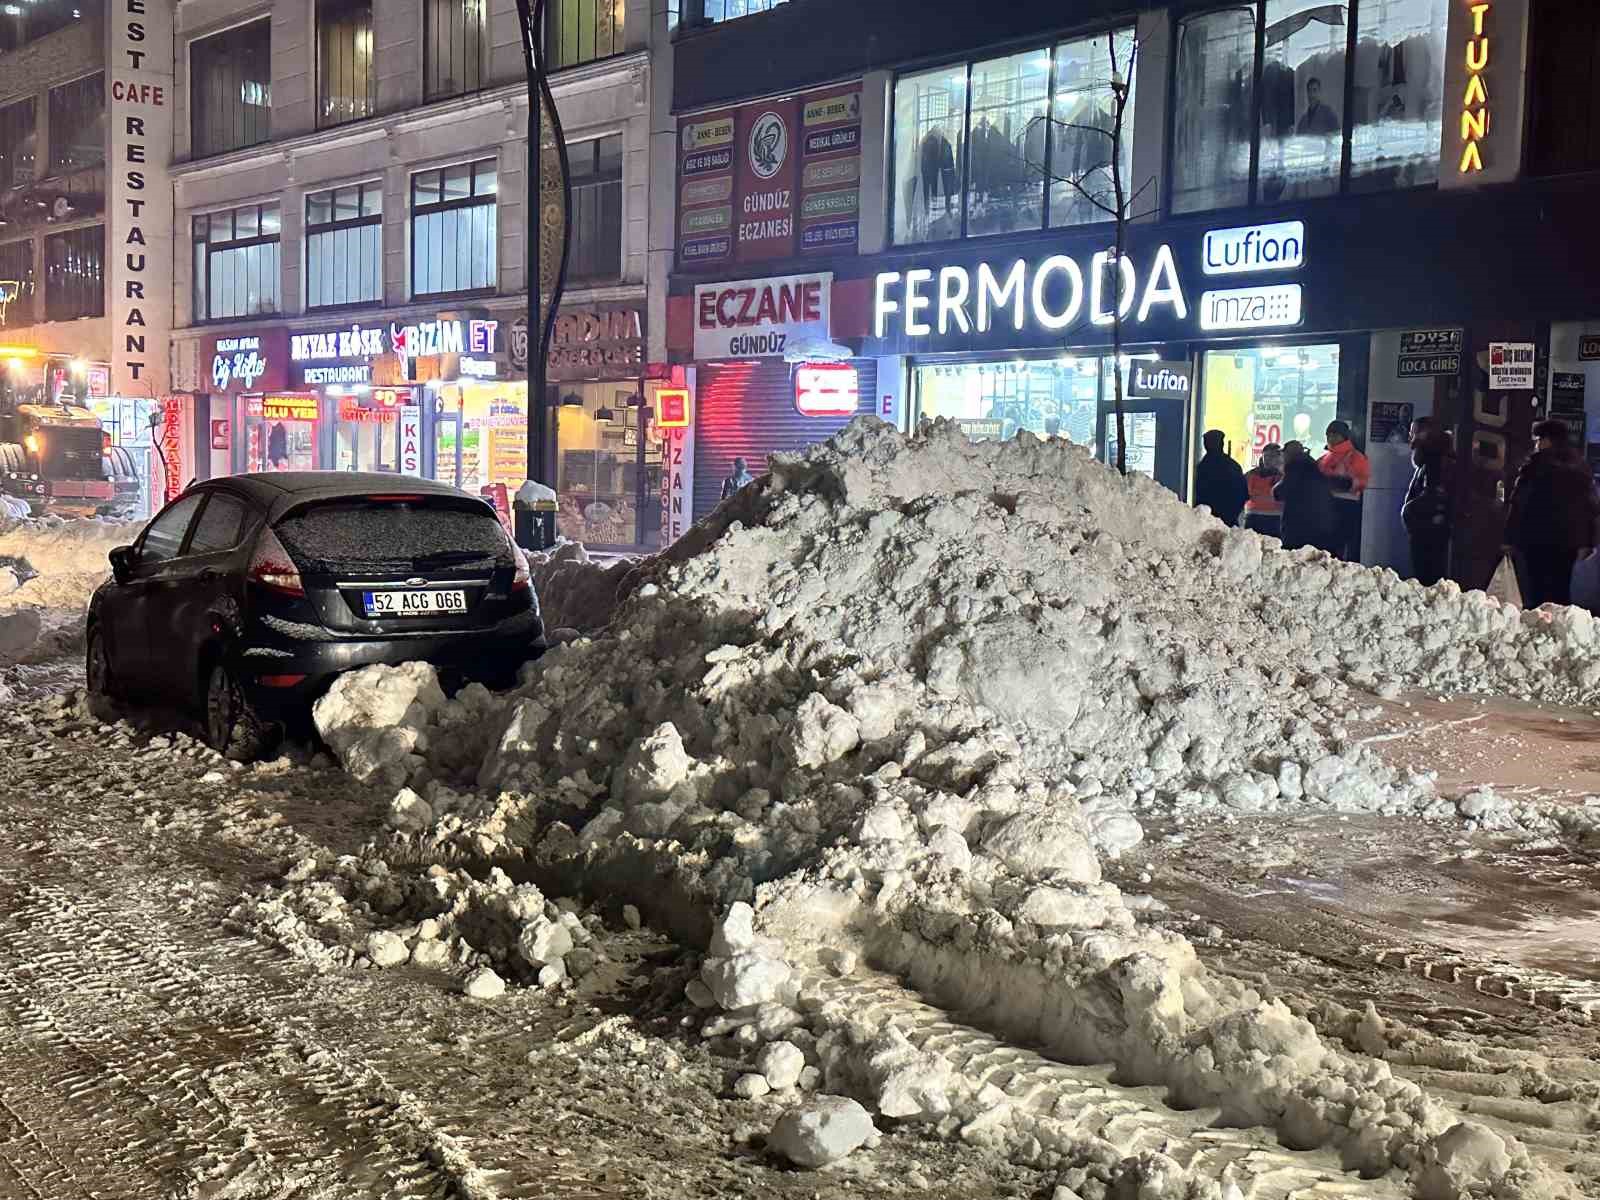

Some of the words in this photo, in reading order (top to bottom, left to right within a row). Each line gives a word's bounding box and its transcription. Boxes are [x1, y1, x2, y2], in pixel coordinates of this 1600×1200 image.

[112, 80, 164, 106] CAFE
[1460, 4, 1489, 173] TUANA
[744, 189, 790, 213] GÜNDÜZ
[739, 214, 793, 241] ECZANESİ
[126, 116, 146, 380] RESTAURANT
[1207, 230, 1299, 268] Lufian
[874, 244, 1188, 338] FERMODA
[699, 281, 821, 330] ECZANE
[1211, 293, 1266, 323] imza
[291, 332, 337, 360] BEYAZ
[407, 319, 464, 357] BİZİM
[469, 319, 498, 354] ET
[729, 332, 787, 355] GÜNDÜZ
[304, 365, 369, 385] RESTAURANT
[1135, 367, 1189, 392] Lufian
[1254, 423, 1281, 447] 50
[672, 429, 684, 538] CZANE
[374, 594, 394, 610] 52
[402, 592, 429, 609] ACG
[435, 592, 463, 608] 066
